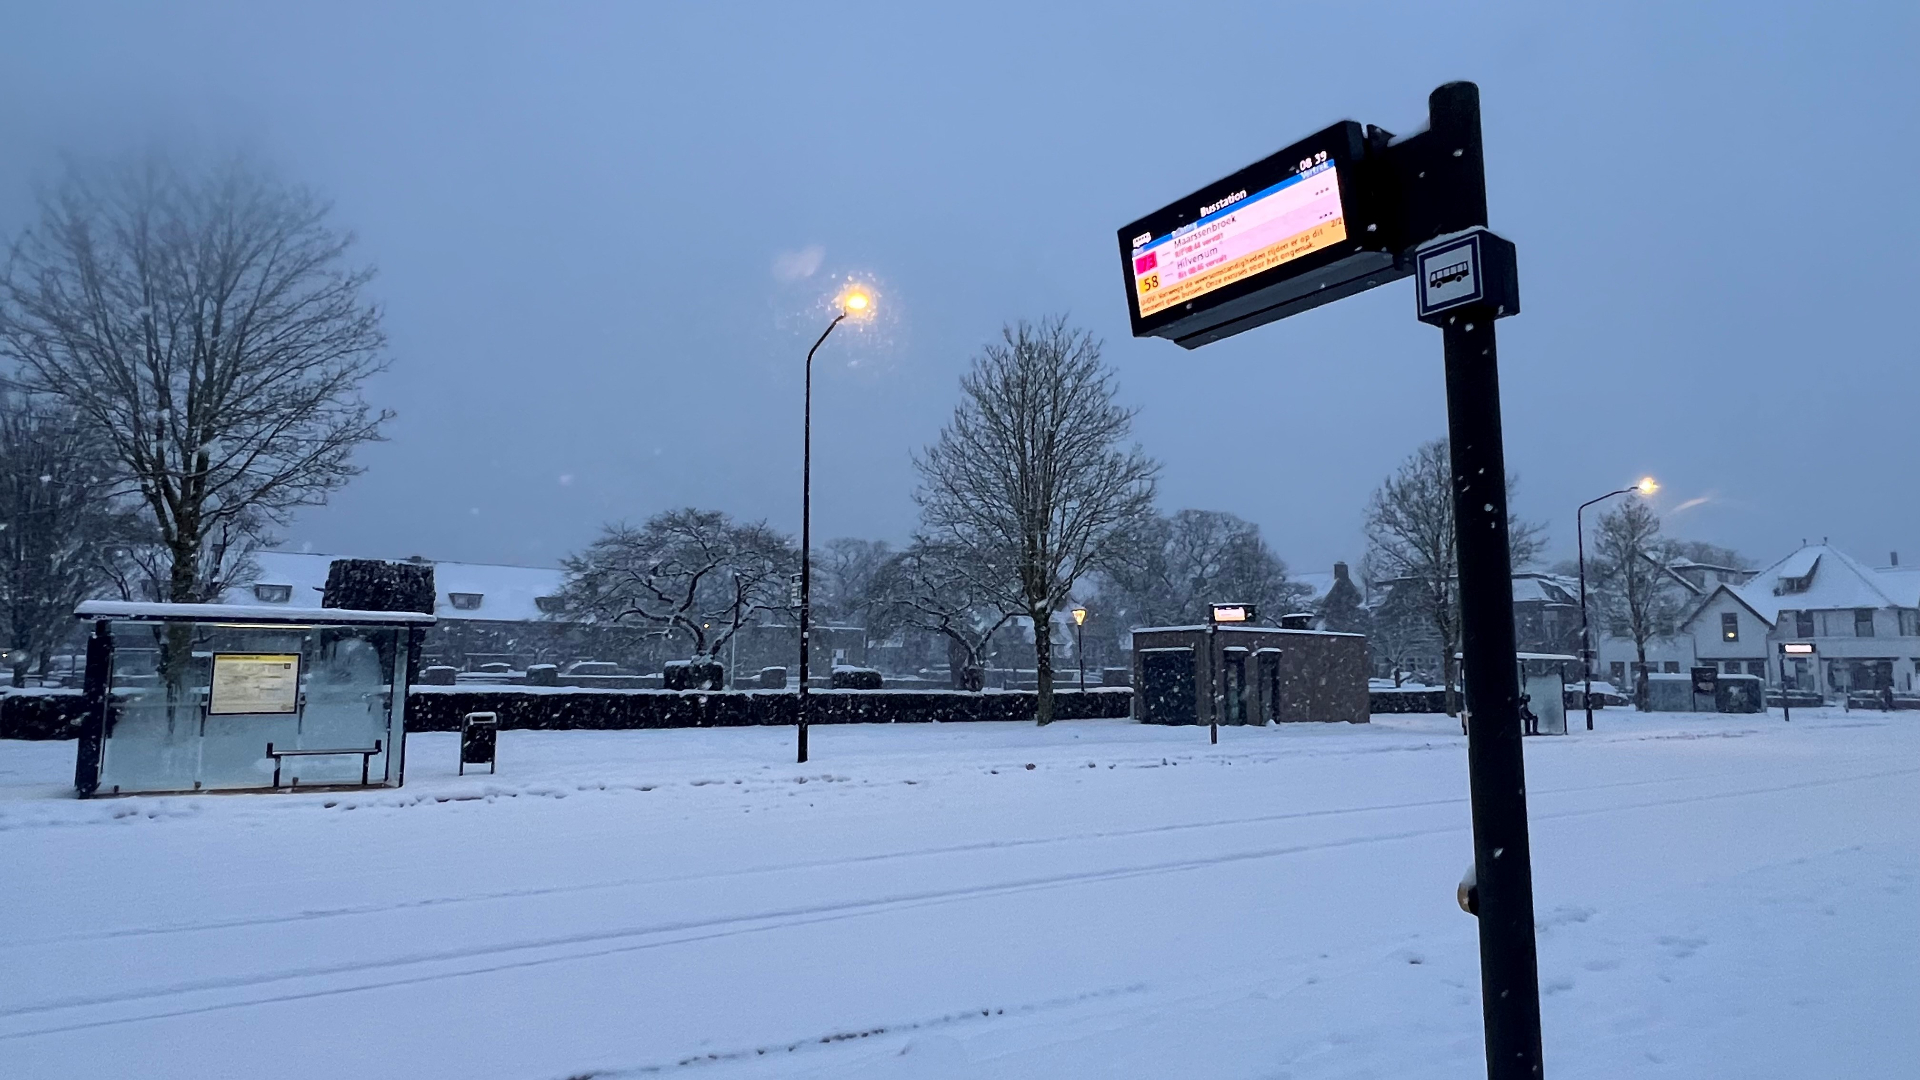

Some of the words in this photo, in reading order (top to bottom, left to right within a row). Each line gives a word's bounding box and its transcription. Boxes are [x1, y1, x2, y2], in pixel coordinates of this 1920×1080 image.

[1200, 190, 1247, 217] Busstation
[1174, 215, 1236, 248] Maarssenbroek
[1331, 218, 1342, 227] 2/2
[1268, 242, 1288, 256] rijden
[1300, 235, 1310, 243] op
[1312, 228, 1323, 237] dit
[1177, 248, 1217, 269] Hilversum
[1206, 278, 1221, 288] Onze
[1266, 255, 1278, 265] het
[1144, 275, 1158, 291] 58
